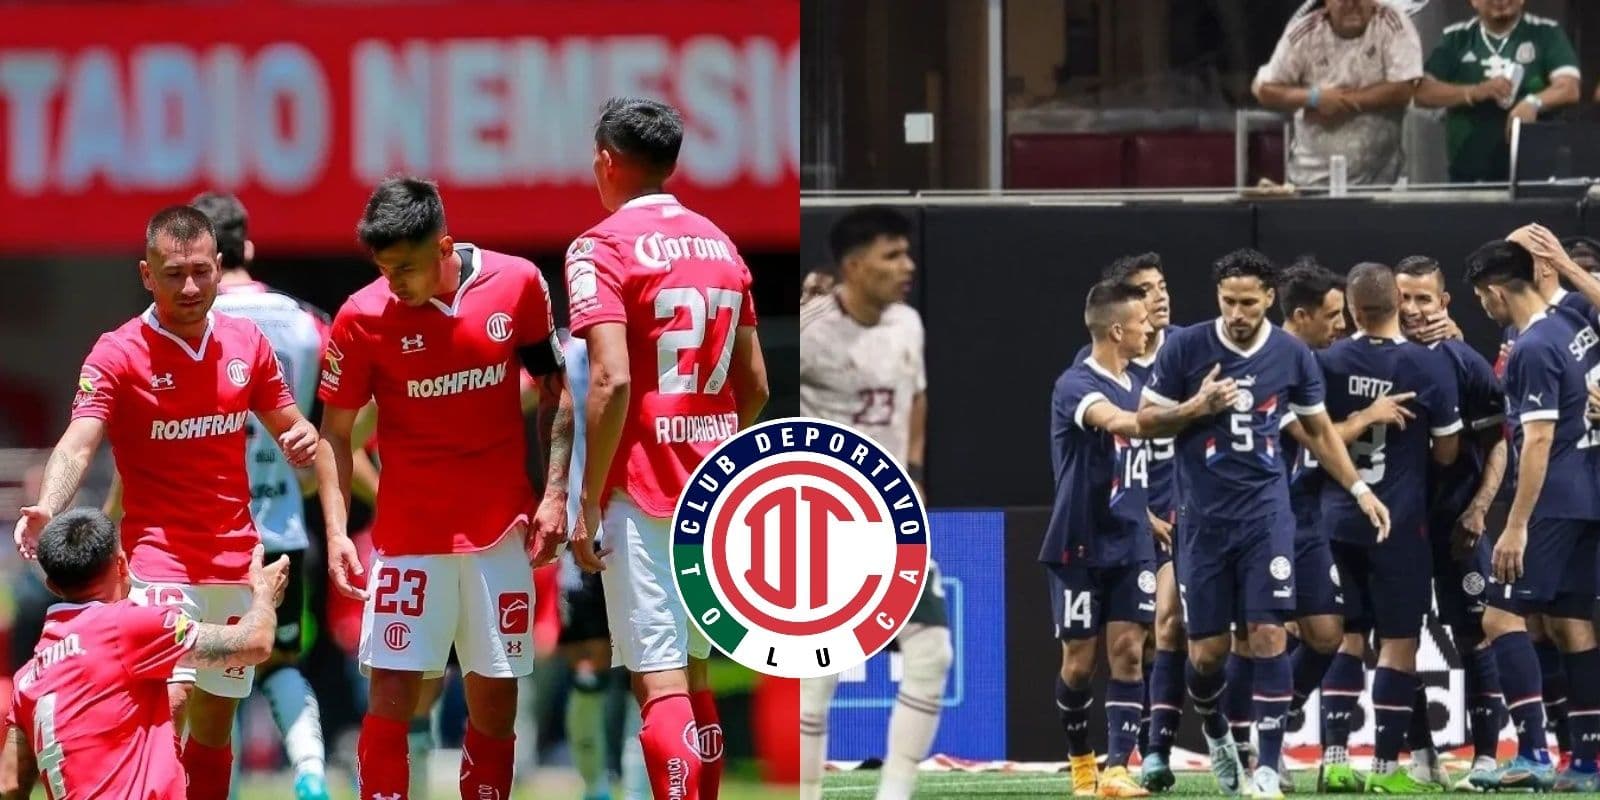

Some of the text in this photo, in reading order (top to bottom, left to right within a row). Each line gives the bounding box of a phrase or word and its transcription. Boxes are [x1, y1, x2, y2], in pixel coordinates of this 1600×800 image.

[0, 43, 331, 193] TADIO
[654, 287, 743, 395] 27
[852, 388, 895, 427] 23
[1230, 414, 1254, 452] 5
[1124, 448, 1149, 489] 14
[374, 566, 428, 617] 23
[1063, 588, 1092, 629] 14
